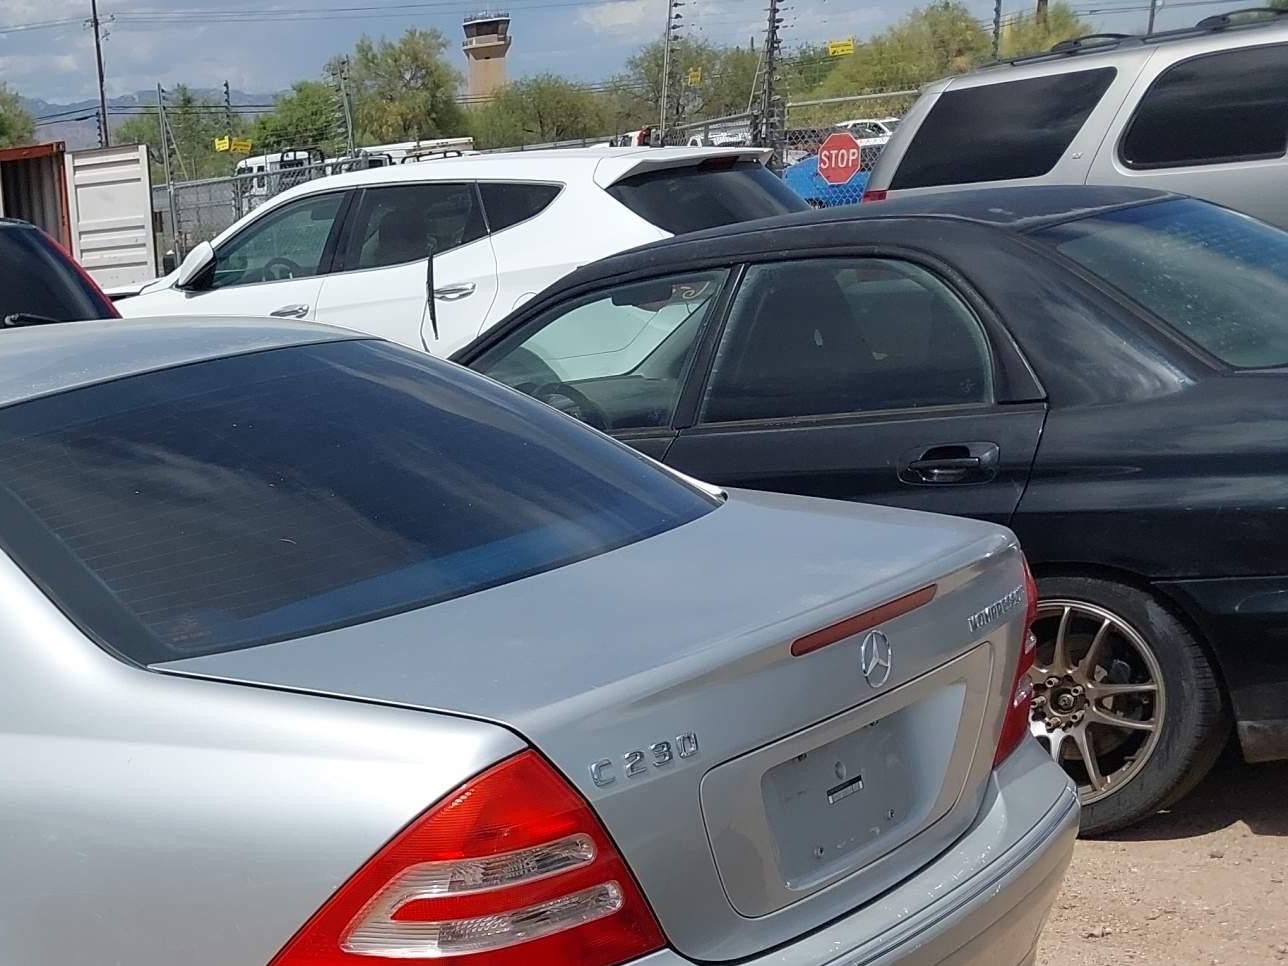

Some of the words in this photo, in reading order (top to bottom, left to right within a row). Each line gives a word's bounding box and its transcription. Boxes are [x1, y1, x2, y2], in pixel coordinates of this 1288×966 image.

[820, 148, 858, 169] STOP
[590, 759, 616, 788] C
[623, 732, 699, 778] 230
